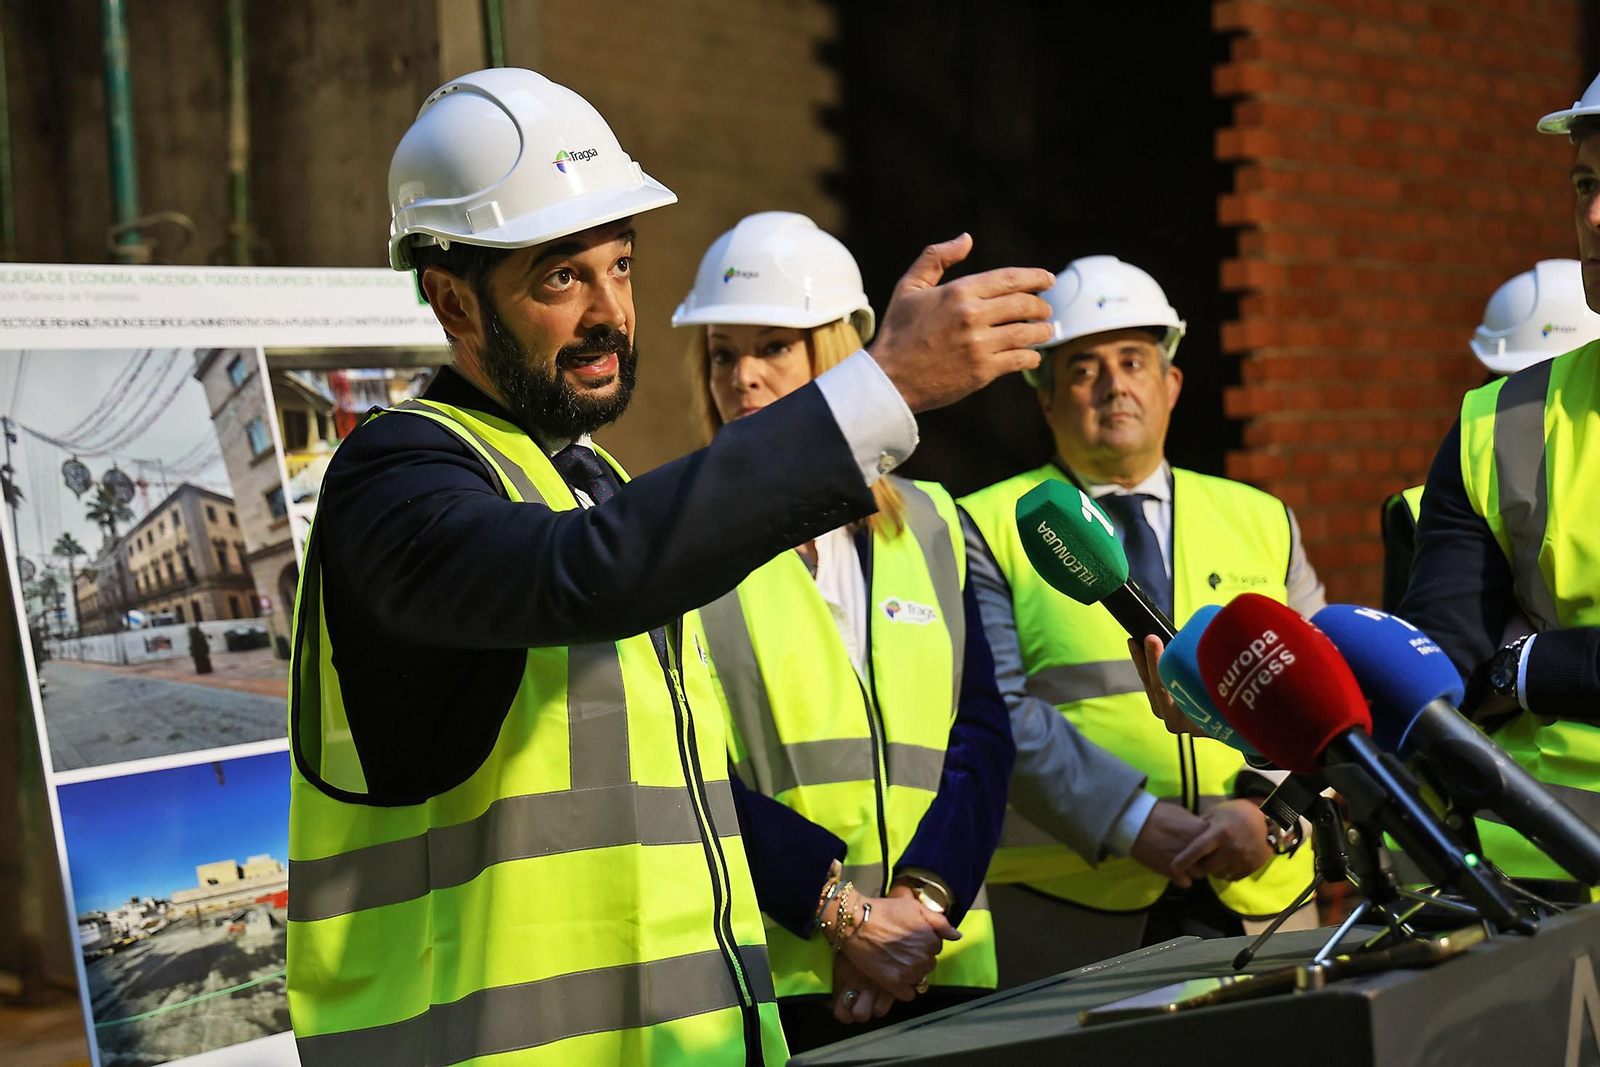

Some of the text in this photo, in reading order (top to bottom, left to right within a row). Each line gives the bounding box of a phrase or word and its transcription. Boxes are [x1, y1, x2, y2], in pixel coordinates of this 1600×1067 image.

[569, 148, 598, 162] Tragsa
[1036, 520, 1098, 587] TELEONUBA
[1218, 629, 1278, 697] europa
[1241, 649, 1296, 710] press
